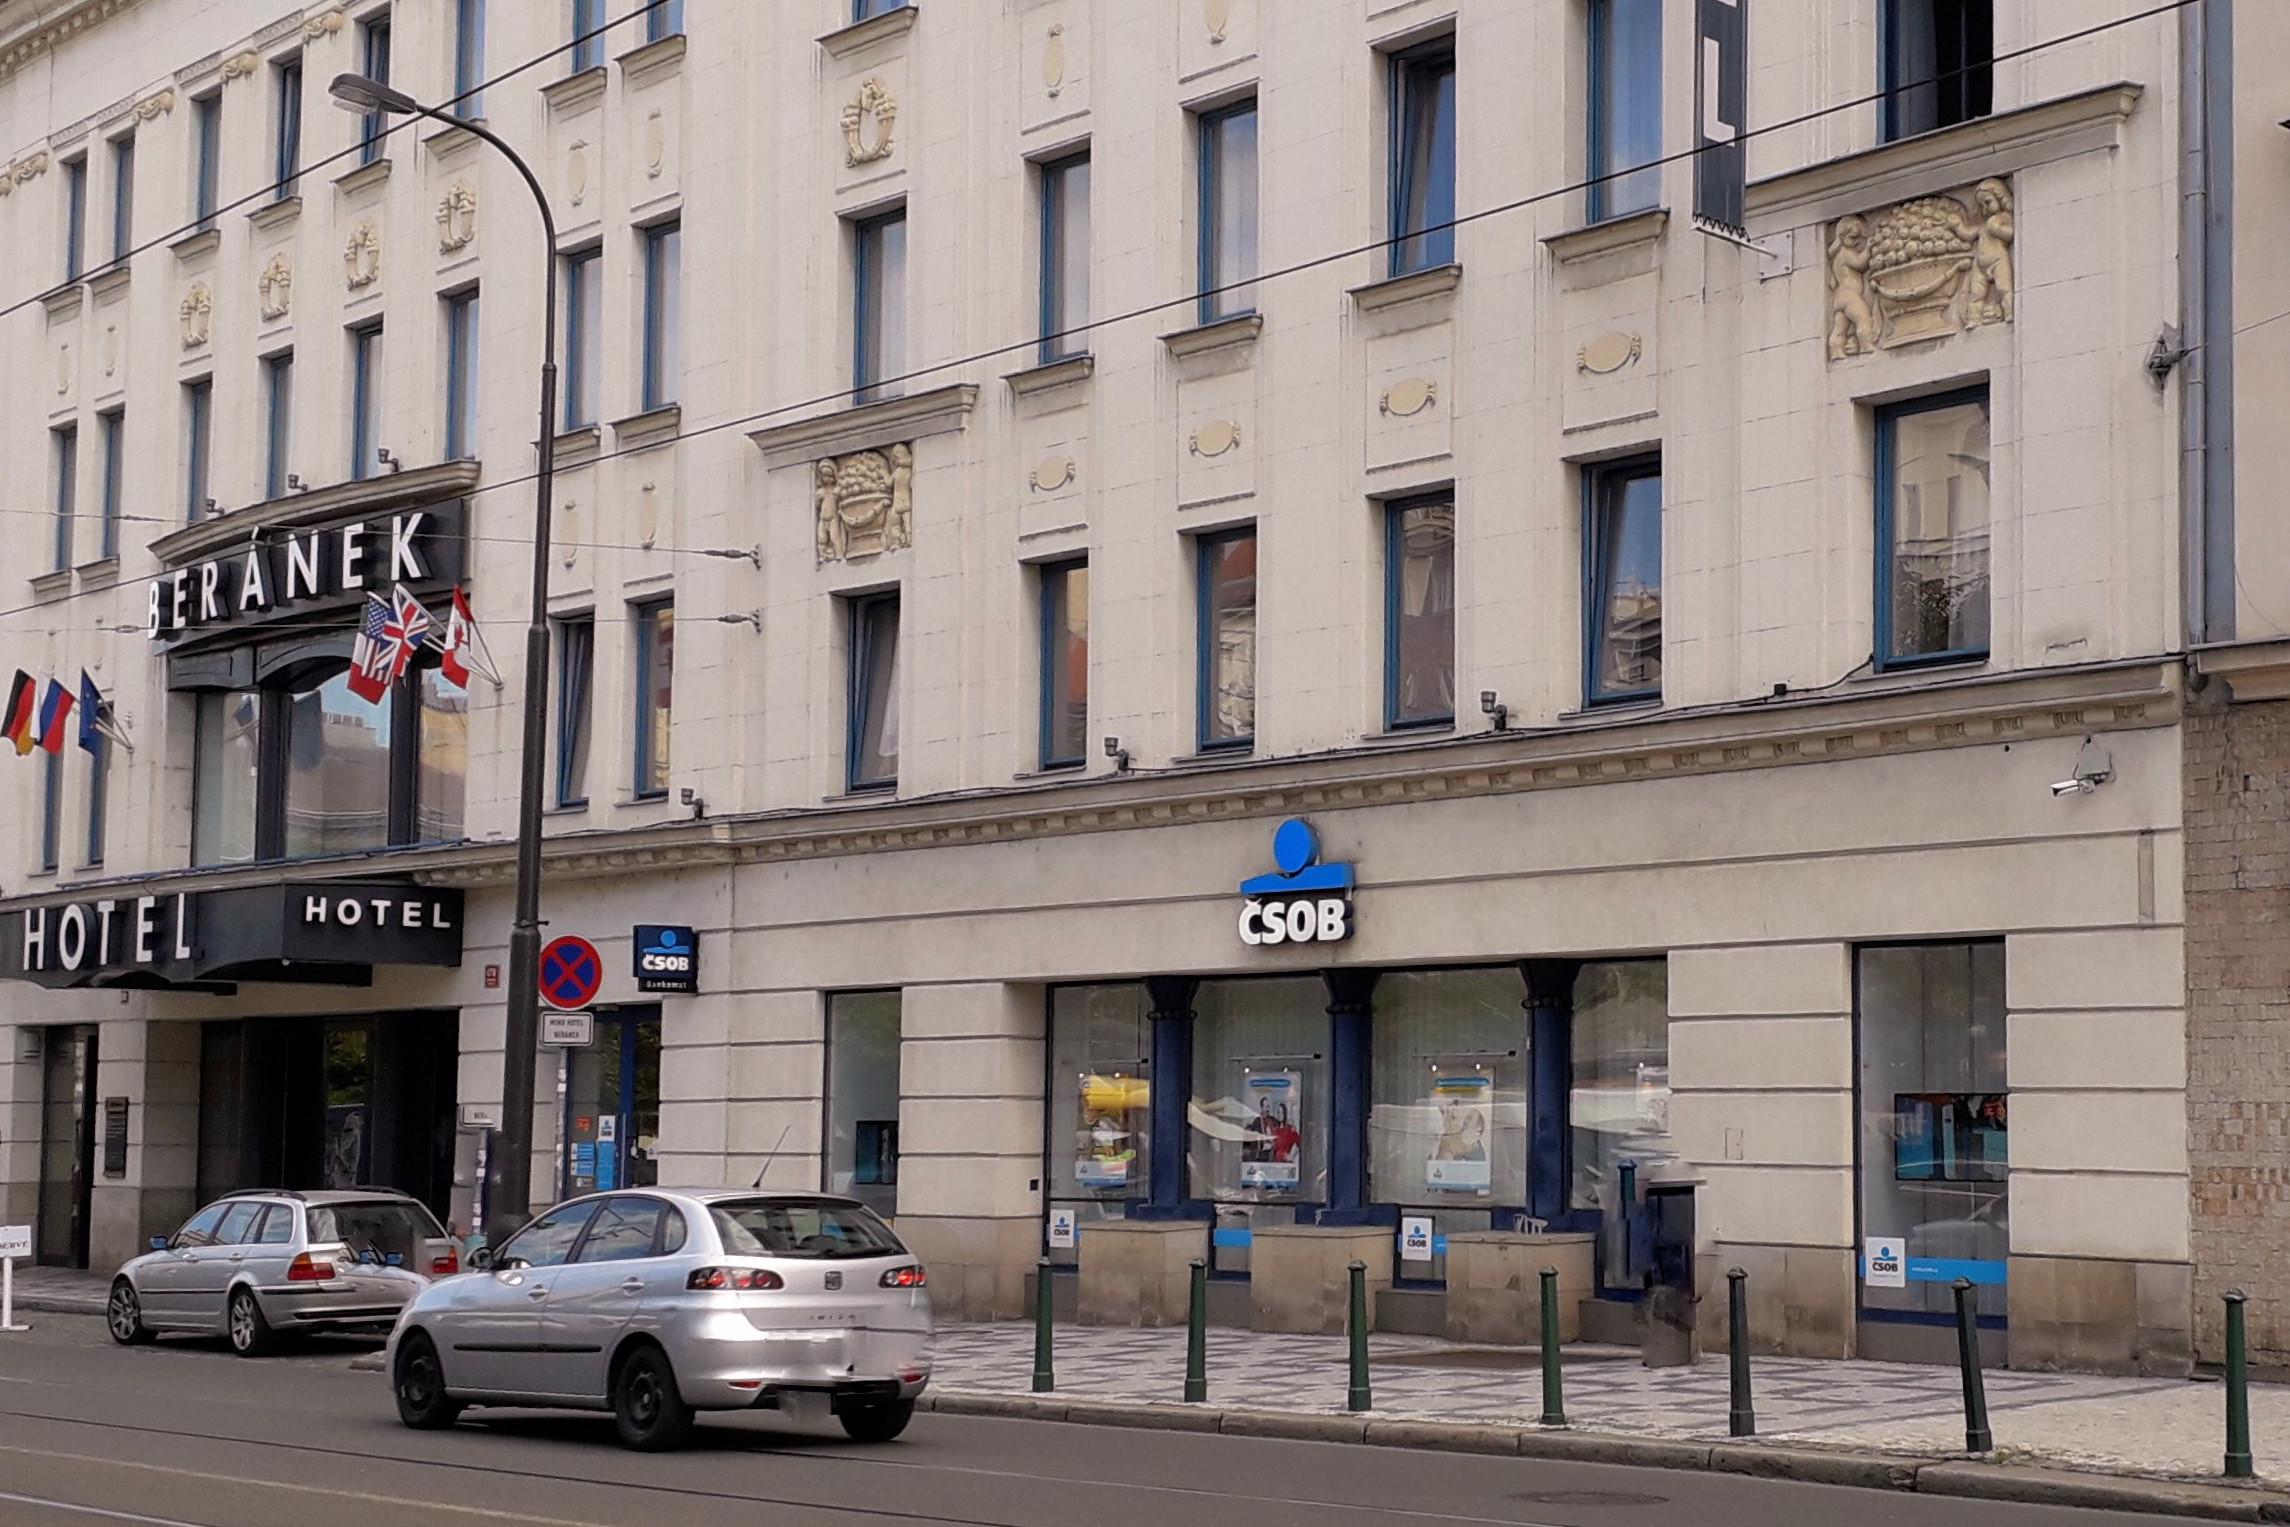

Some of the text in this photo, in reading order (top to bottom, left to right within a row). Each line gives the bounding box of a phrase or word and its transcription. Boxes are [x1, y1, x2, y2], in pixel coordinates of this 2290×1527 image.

[148, 512, 424, 640] BERÁNEK
[23, 892, 190, 971] HOTEL
[306, 895, 450, 928] HOTEL
[1238, 897, 1346, 945] ČSOB
[642, 953, 689, 971] ČSOB
